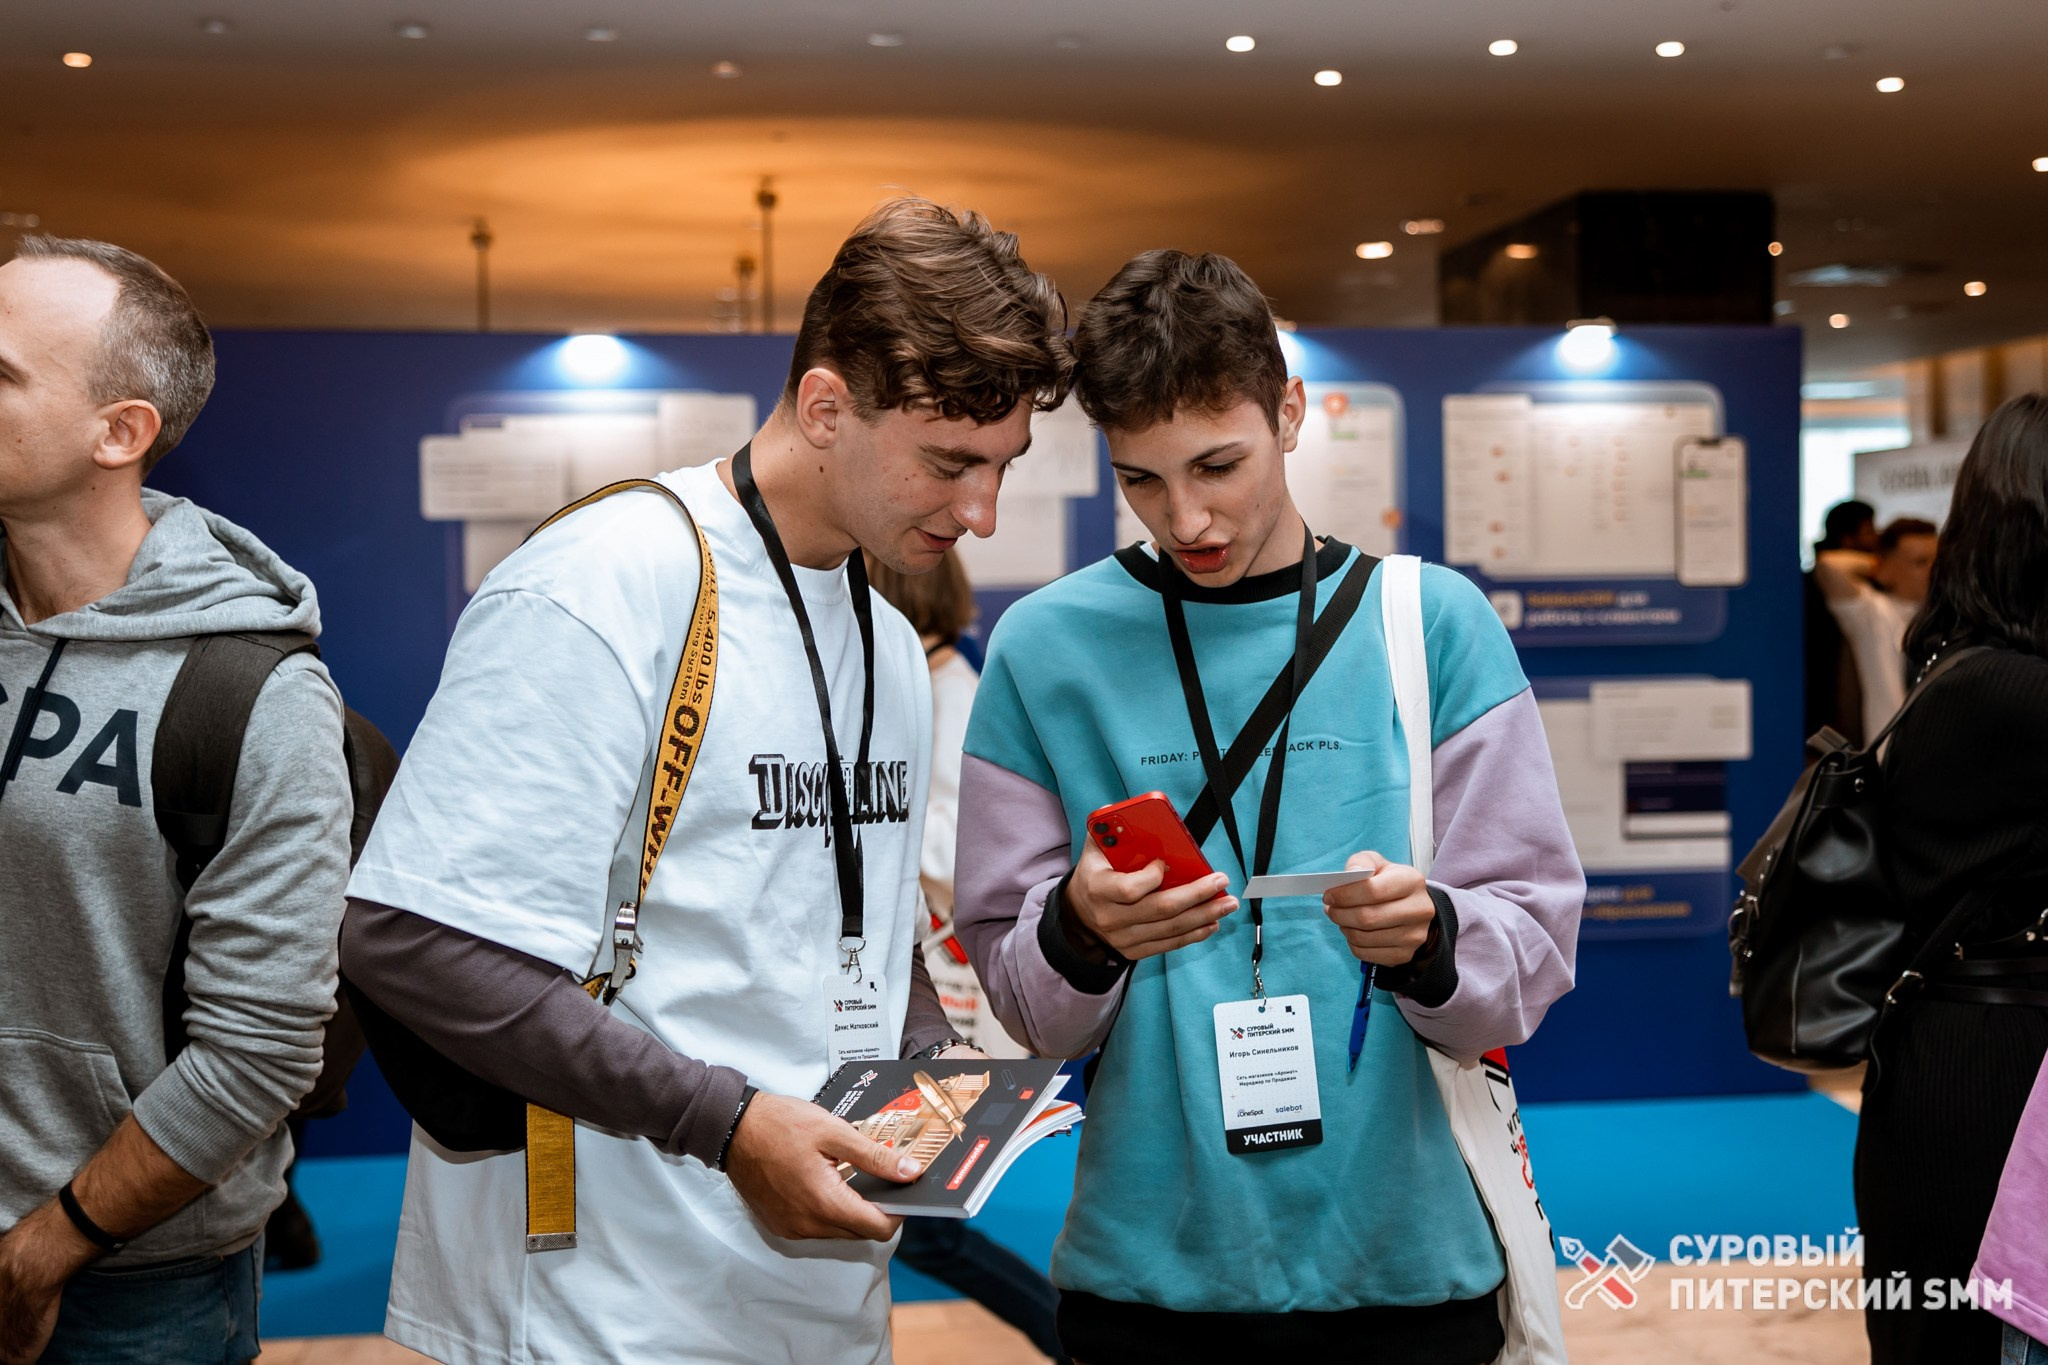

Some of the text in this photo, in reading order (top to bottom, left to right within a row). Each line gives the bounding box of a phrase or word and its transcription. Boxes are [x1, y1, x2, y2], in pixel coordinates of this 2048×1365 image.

[693, 609, 716, 705] 5,400 lbs
[680, 649, 698, 700] System
[0, 682, 142, 807] PA
[1141, 752, 1187, 766] FRIDAY:
[1319, 740, 1342, 751] PLS.
[1247, 1023, 1274, 1032] СУРОВЫЙ
[1248, 1028, 1281, 1038] ПИТЕРСКИЙ
[1252, 1045, 1299, 1056] Синельников
[1243, 1128, 1304, 1146] УЧАСТНИК
